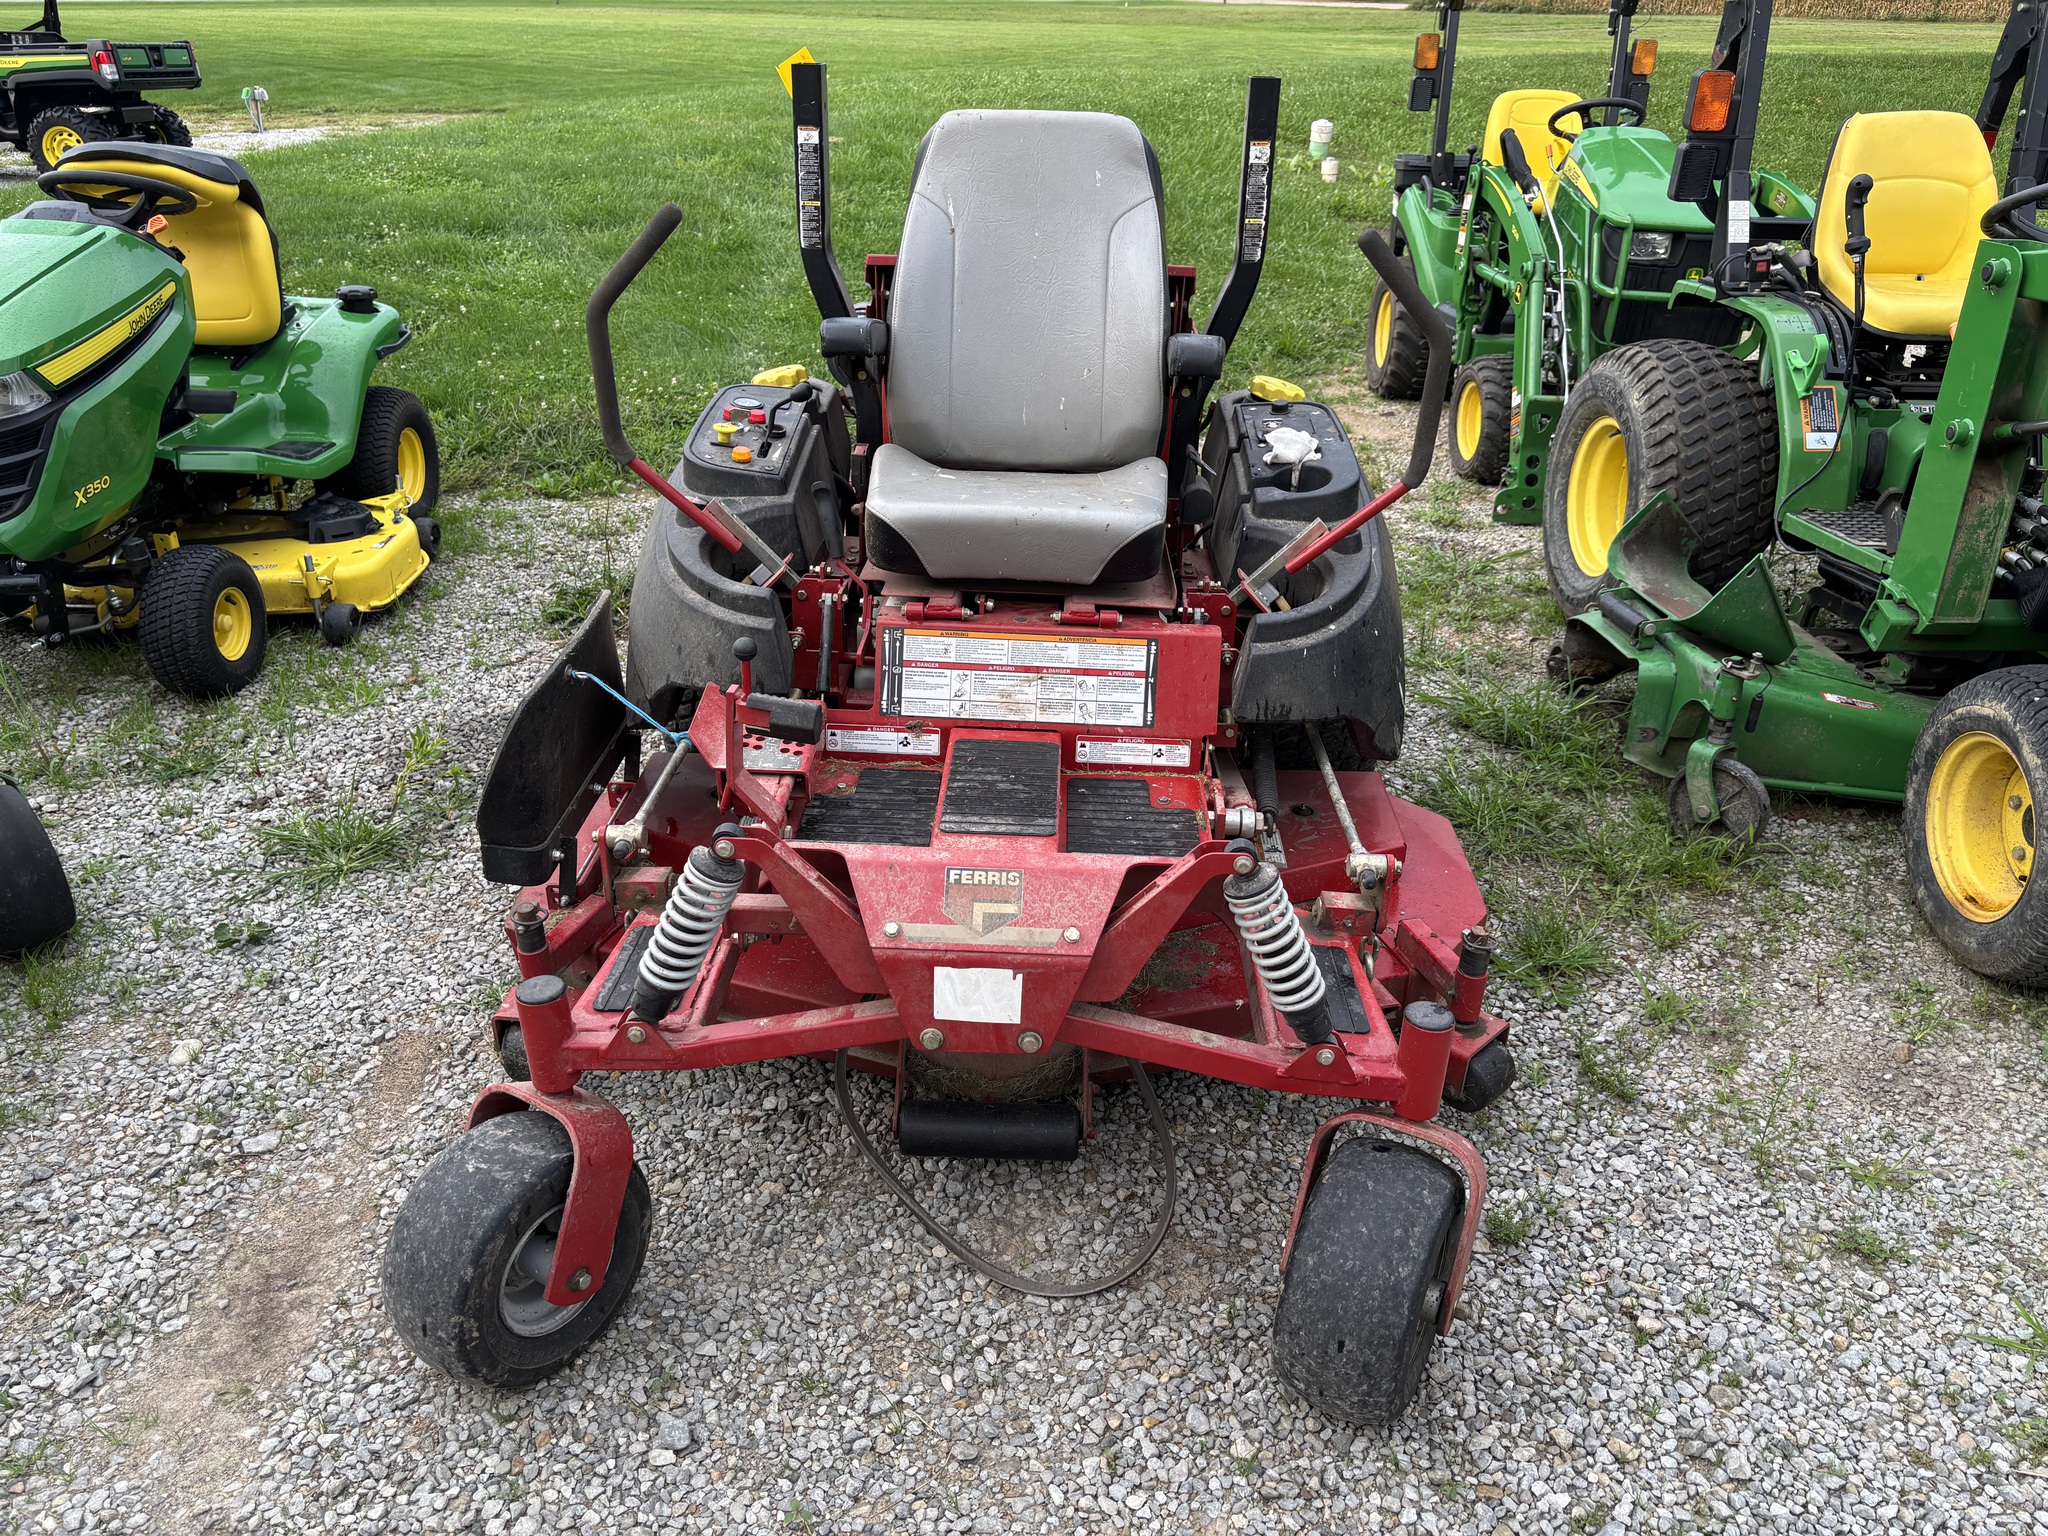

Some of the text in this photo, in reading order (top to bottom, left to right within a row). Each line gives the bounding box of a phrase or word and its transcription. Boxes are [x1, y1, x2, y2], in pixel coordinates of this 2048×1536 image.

[128, 294, 165, 335] JOHN DEERE
[73, 475, 110, 509] X350
[949, 869, 1020, 886] FERRIS
